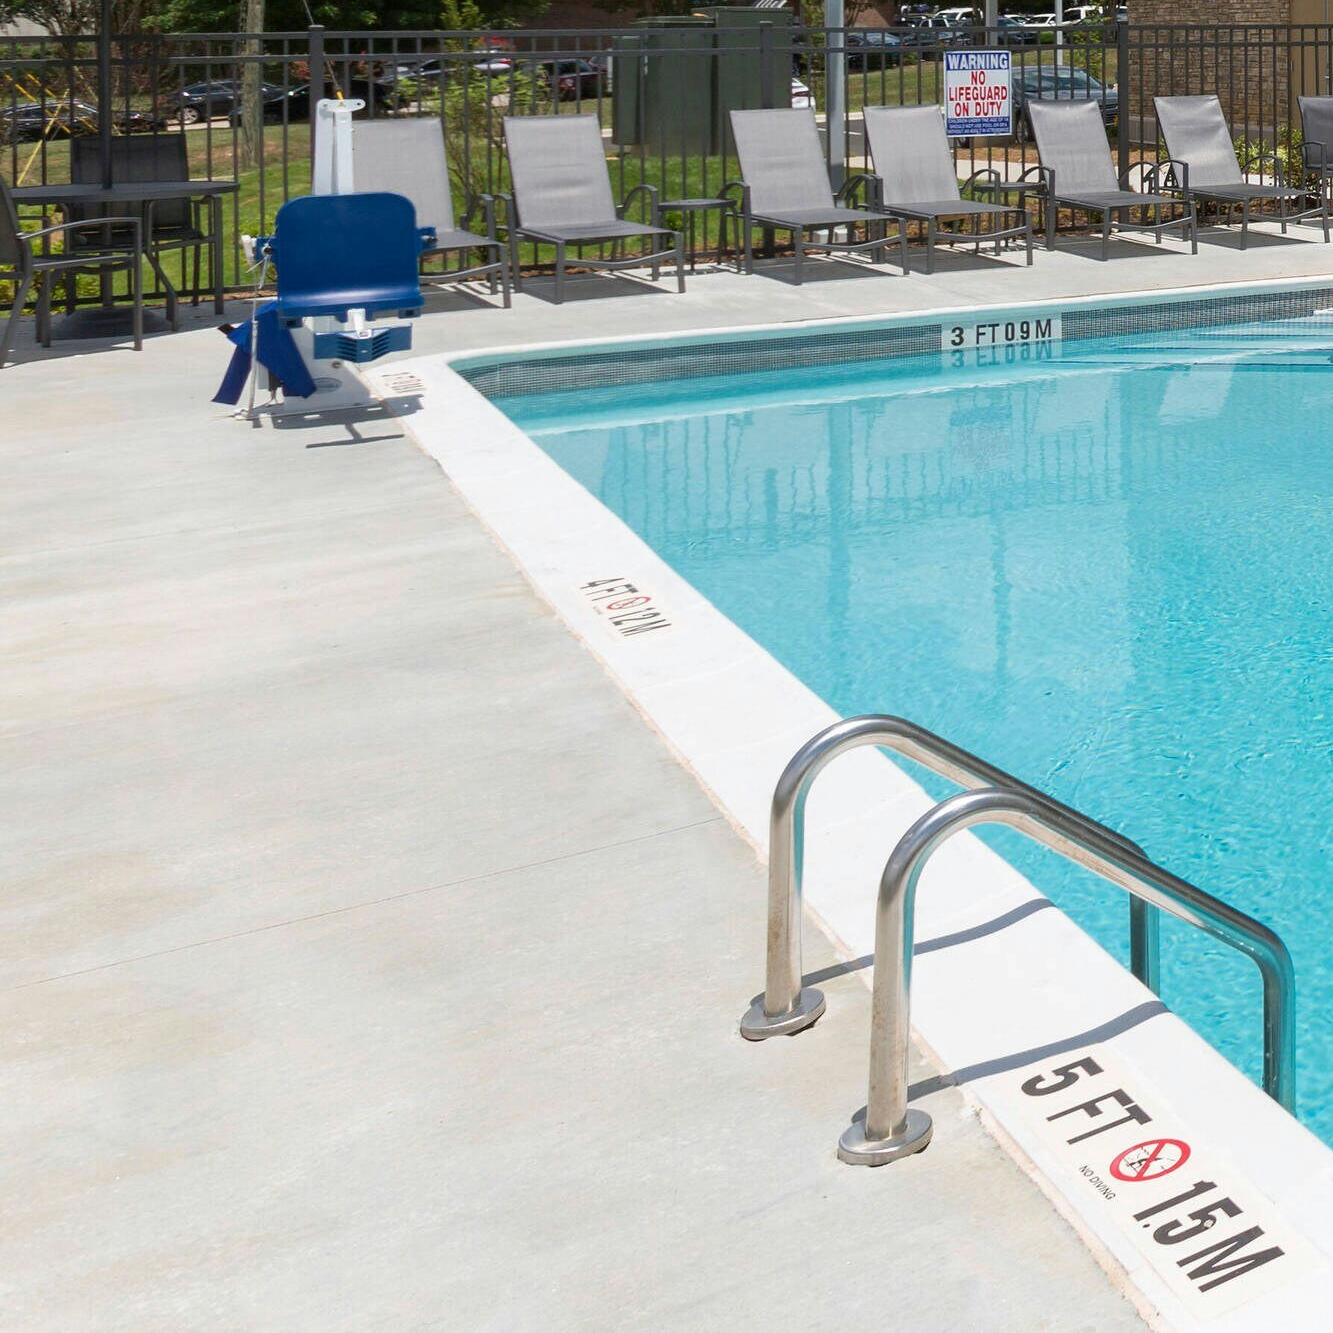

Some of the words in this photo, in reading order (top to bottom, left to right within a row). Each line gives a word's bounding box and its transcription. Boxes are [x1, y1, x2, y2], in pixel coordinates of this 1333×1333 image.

[948, 54, 1008, 70] WARNING
[971, 71, 985, 85] NO
[949, 86, 1007, 101] LIFEGUARD
[955, 102, 969, 116] ON
[975, 102, 1002, 116] DUTY
[951, 326, 964, 346] 3
[976, 323, 999, 344] FT
[580, 578, 624, 589] 4
[584, 584, 639, 601] FT
[1021, 1056, 1104, 1096] 5
[1045, 1088, 1153, 1145] FT
[1078, 1165, 1094, 1176] NO
[1089, 1176, 1116, 1200] DIVING
